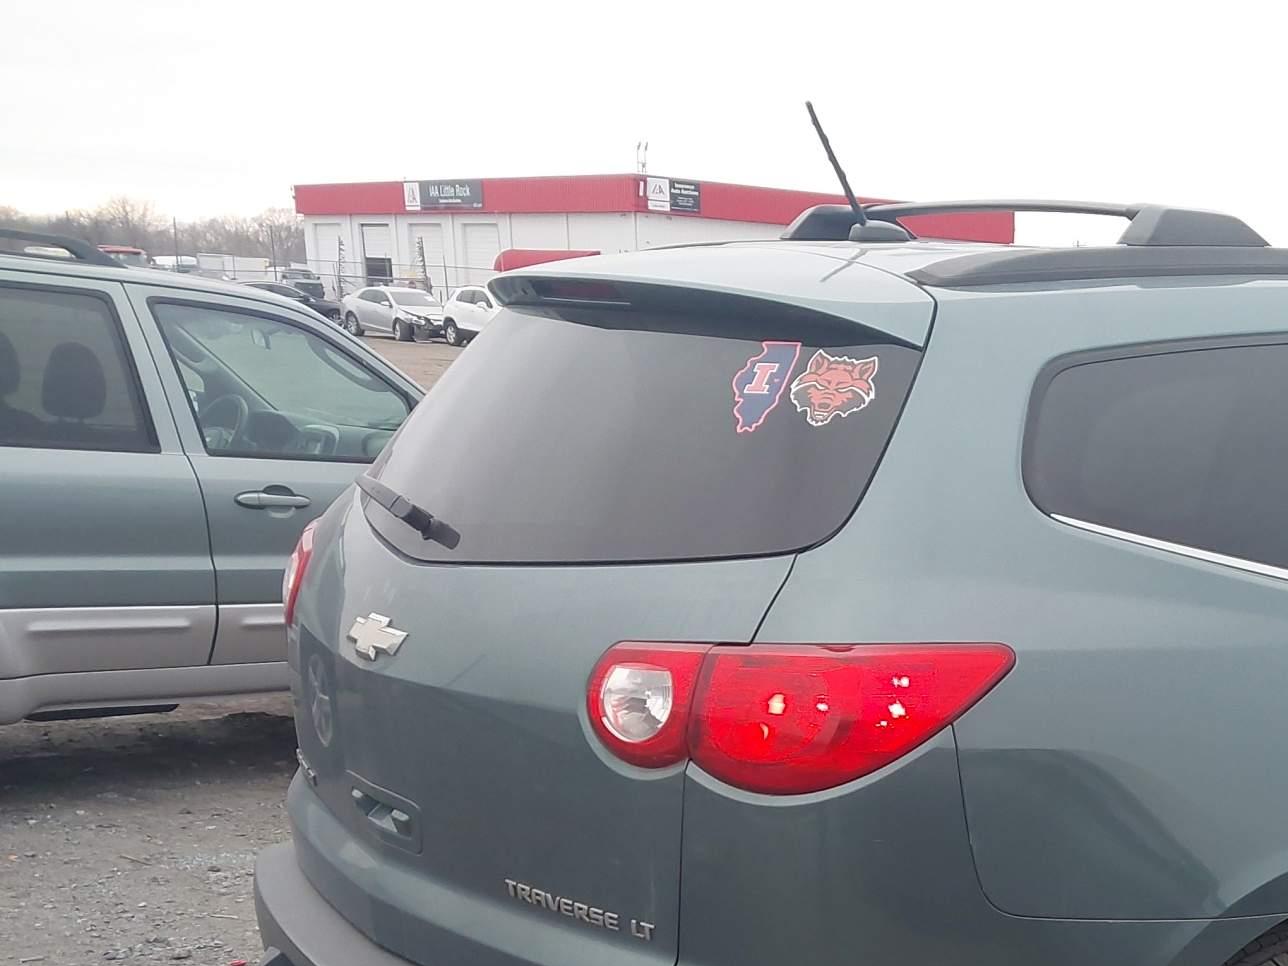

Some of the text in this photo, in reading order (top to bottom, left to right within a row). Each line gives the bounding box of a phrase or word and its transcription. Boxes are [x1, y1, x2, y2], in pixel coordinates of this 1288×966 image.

[440, 184, 454, 197] Little
[455, 184, 470, 197] Rock
[504, 878, 655, 941] TRAVERSE LT
